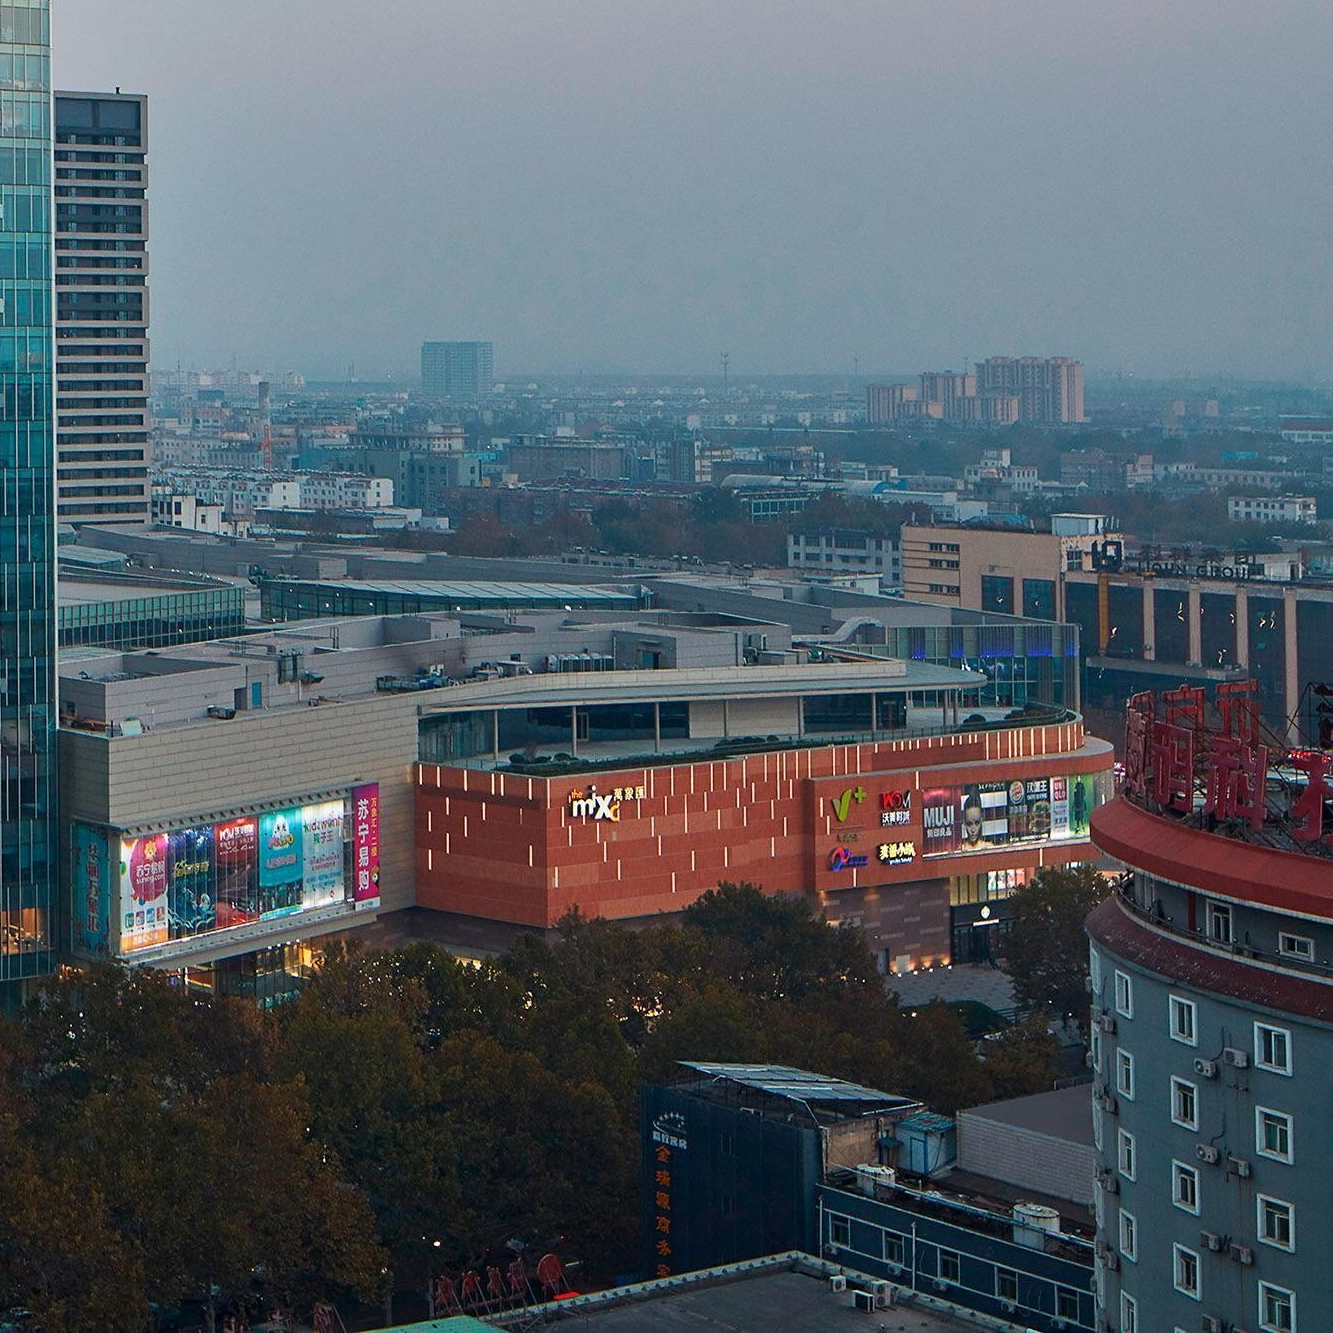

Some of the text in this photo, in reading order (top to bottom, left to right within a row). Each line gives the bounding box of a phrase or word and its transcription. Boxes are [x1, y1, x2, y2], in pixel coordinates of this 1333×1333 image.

[357, 798, 370, 891] 苏宁易购
[923, 805, 955, 828] MUJI
